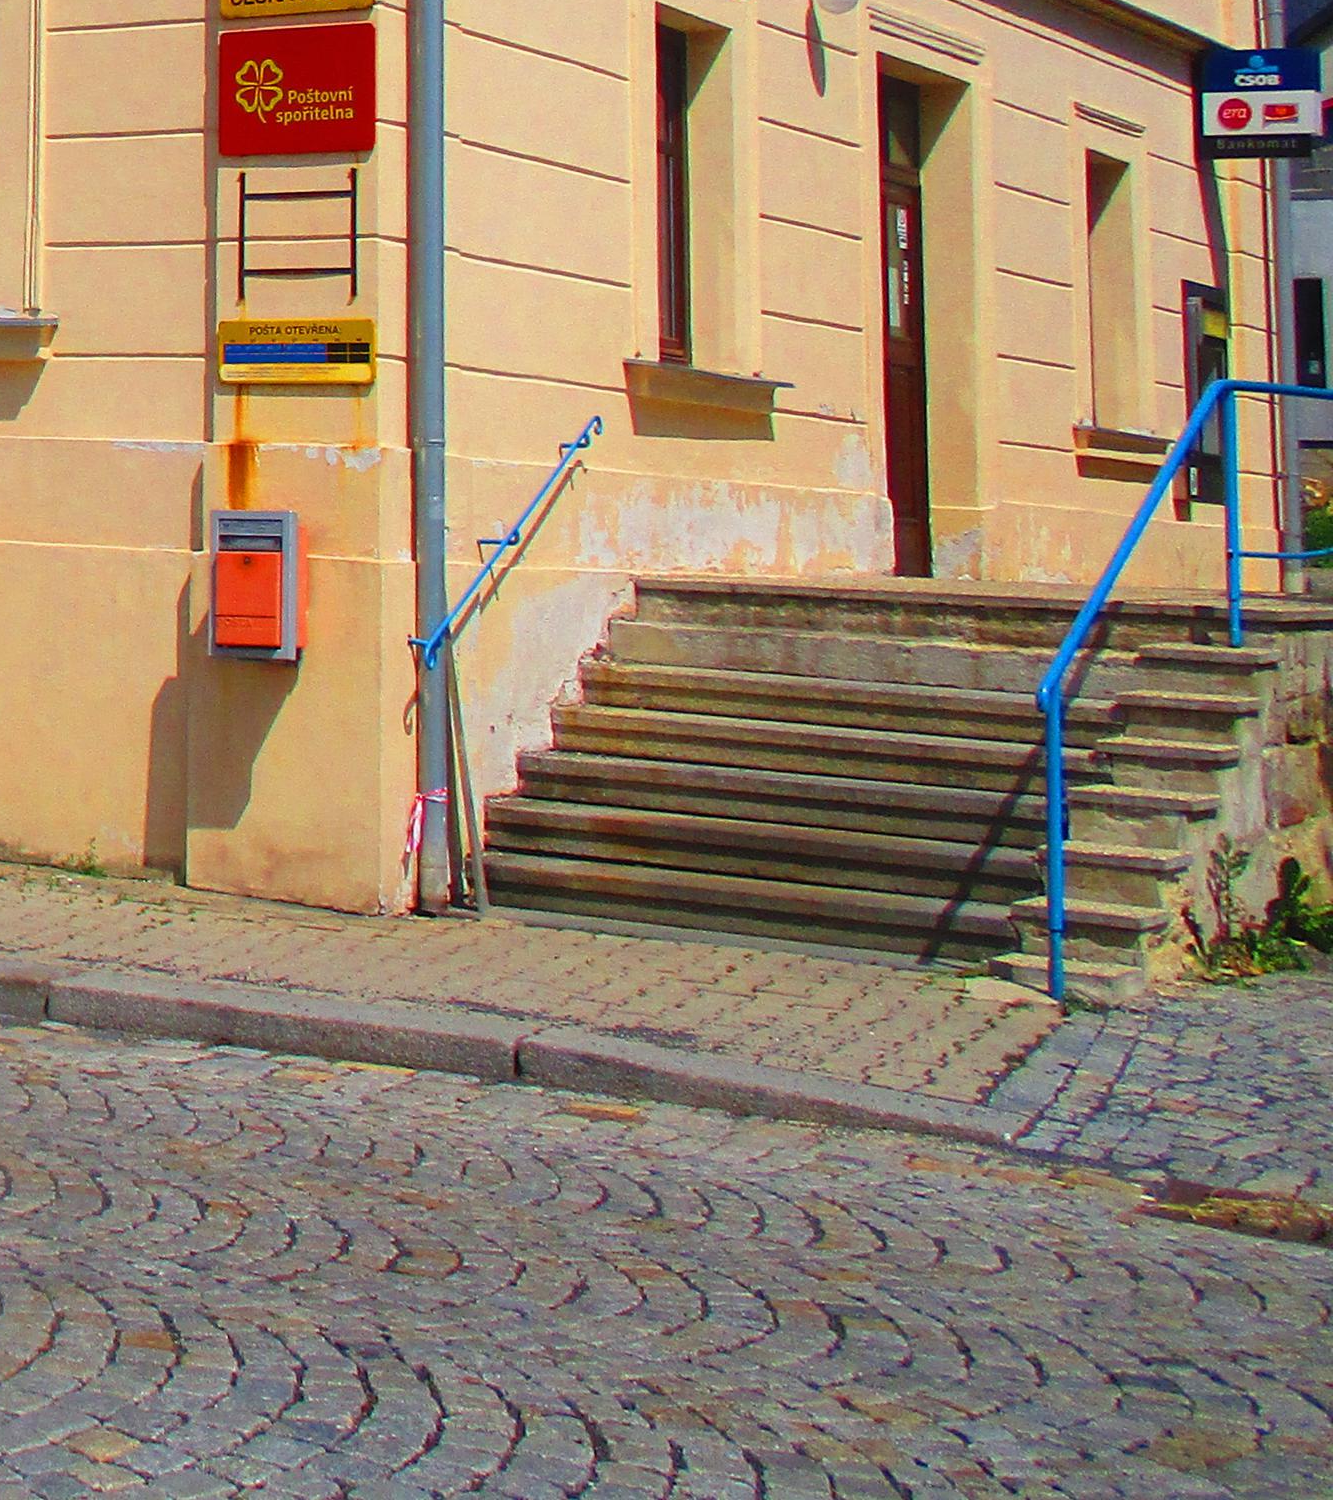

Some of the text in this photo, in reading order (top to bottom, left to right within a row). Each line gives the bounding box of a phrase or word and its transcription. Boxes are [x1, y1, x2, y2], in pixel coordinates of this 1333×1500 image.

[288, 86, 353, 104] Poštovní
[276, 105, 354, 126] spořitelna
[1222, 107, 1248, 119] era
[1216, 138, 1298, 150] Bankomat
[249, 323, 282, 335] POŠTA
